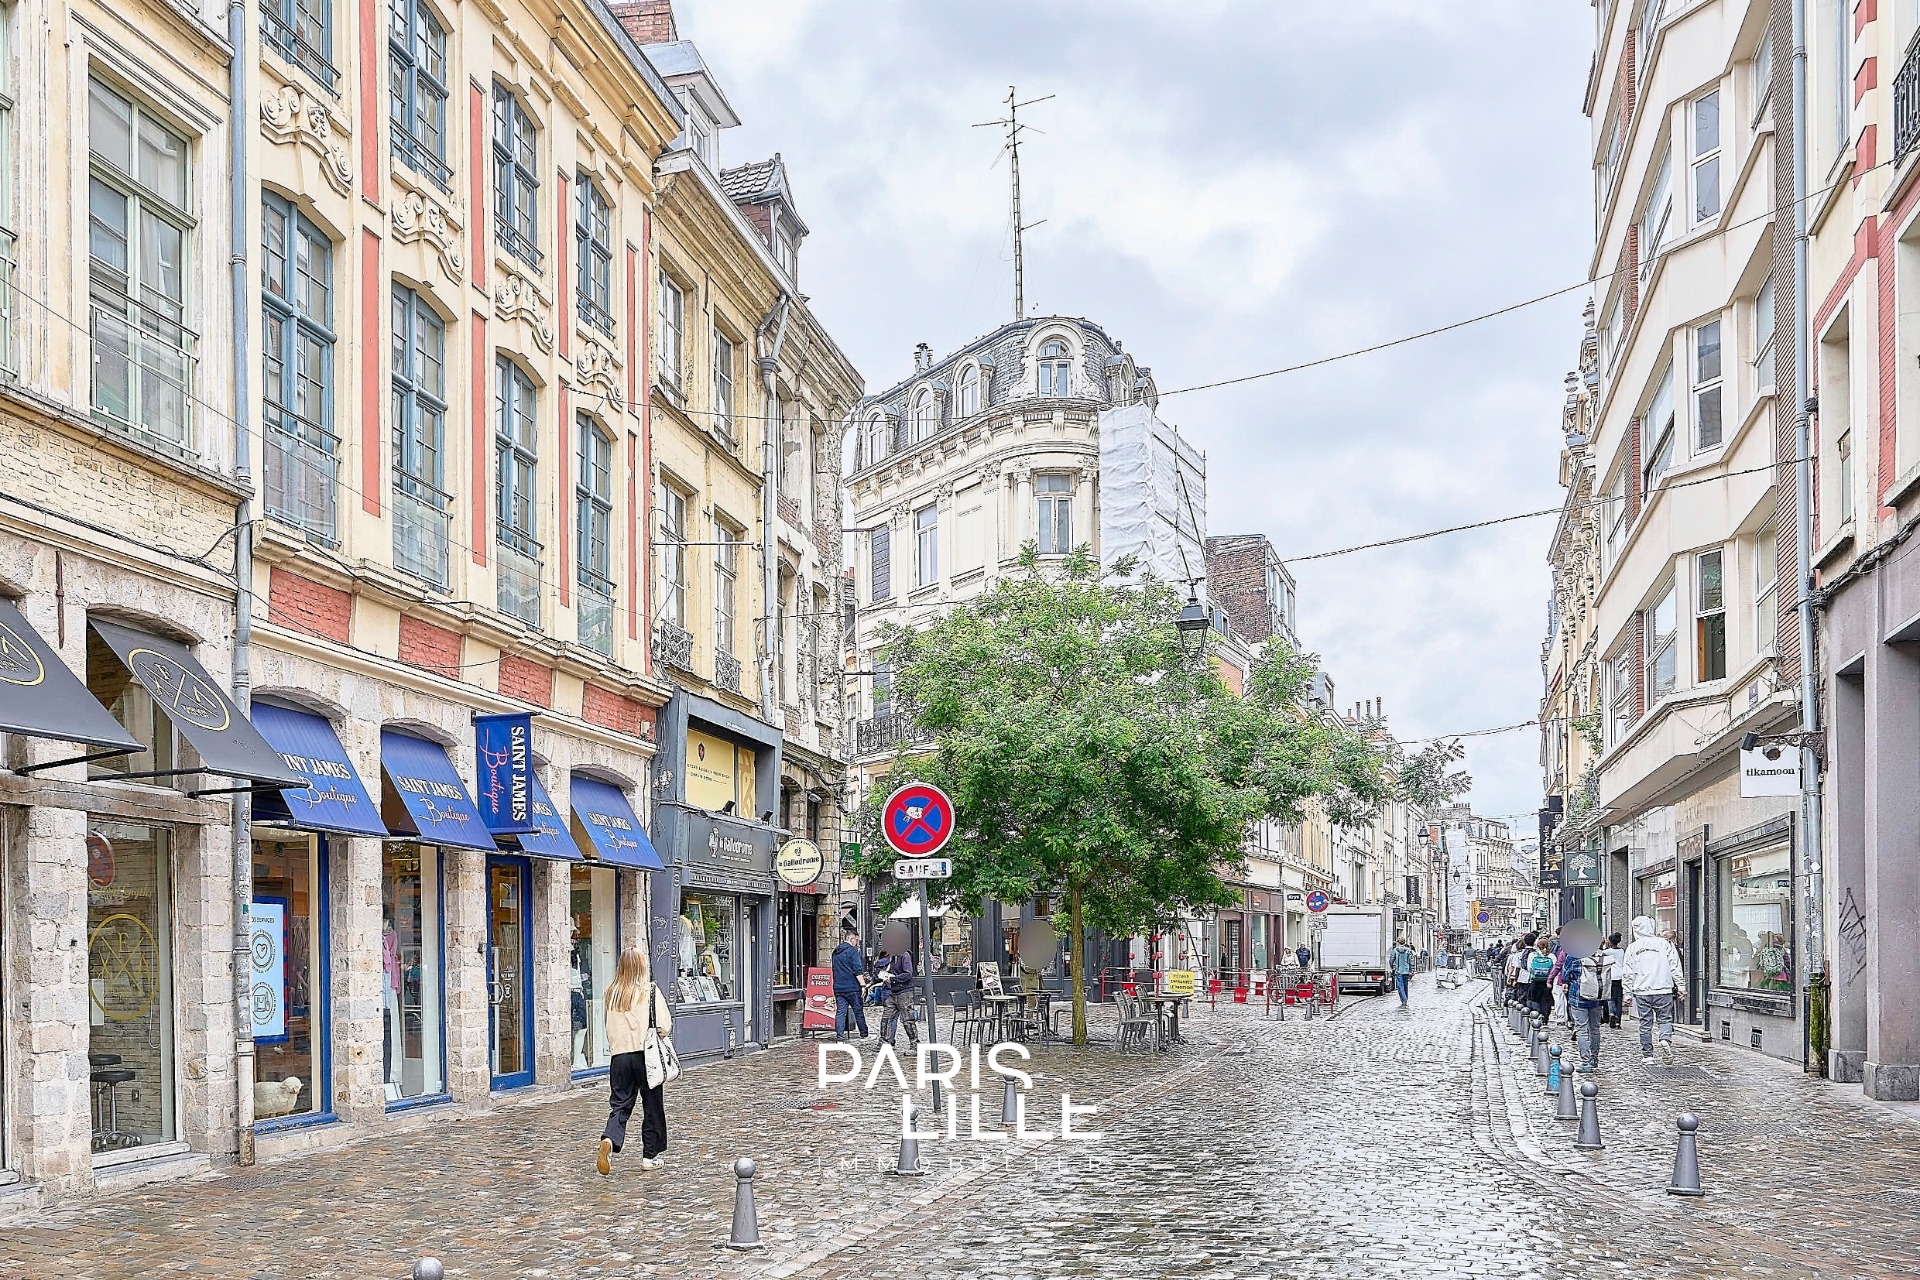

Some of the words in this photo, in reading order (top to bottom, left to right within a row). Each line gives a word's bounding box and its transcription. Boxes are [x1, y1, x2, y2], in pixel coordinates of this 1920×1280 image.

[511, 726, 527, 772] SAINT
[309, 758, 352, 780] JAMES
[480, 728, 509, 815] Boutique
[1746, 767, 1796, 777] tikamoon
[291, 775, 357, 814] Boutique
[396, 775, 431, 796] SAINT
[428, 780, 463, 801] JAMES
[512, 773, 527, 822] JAMES
[418, 796, 470, 830] Boutique
[783, 856, 820, 867] Gallodrome
